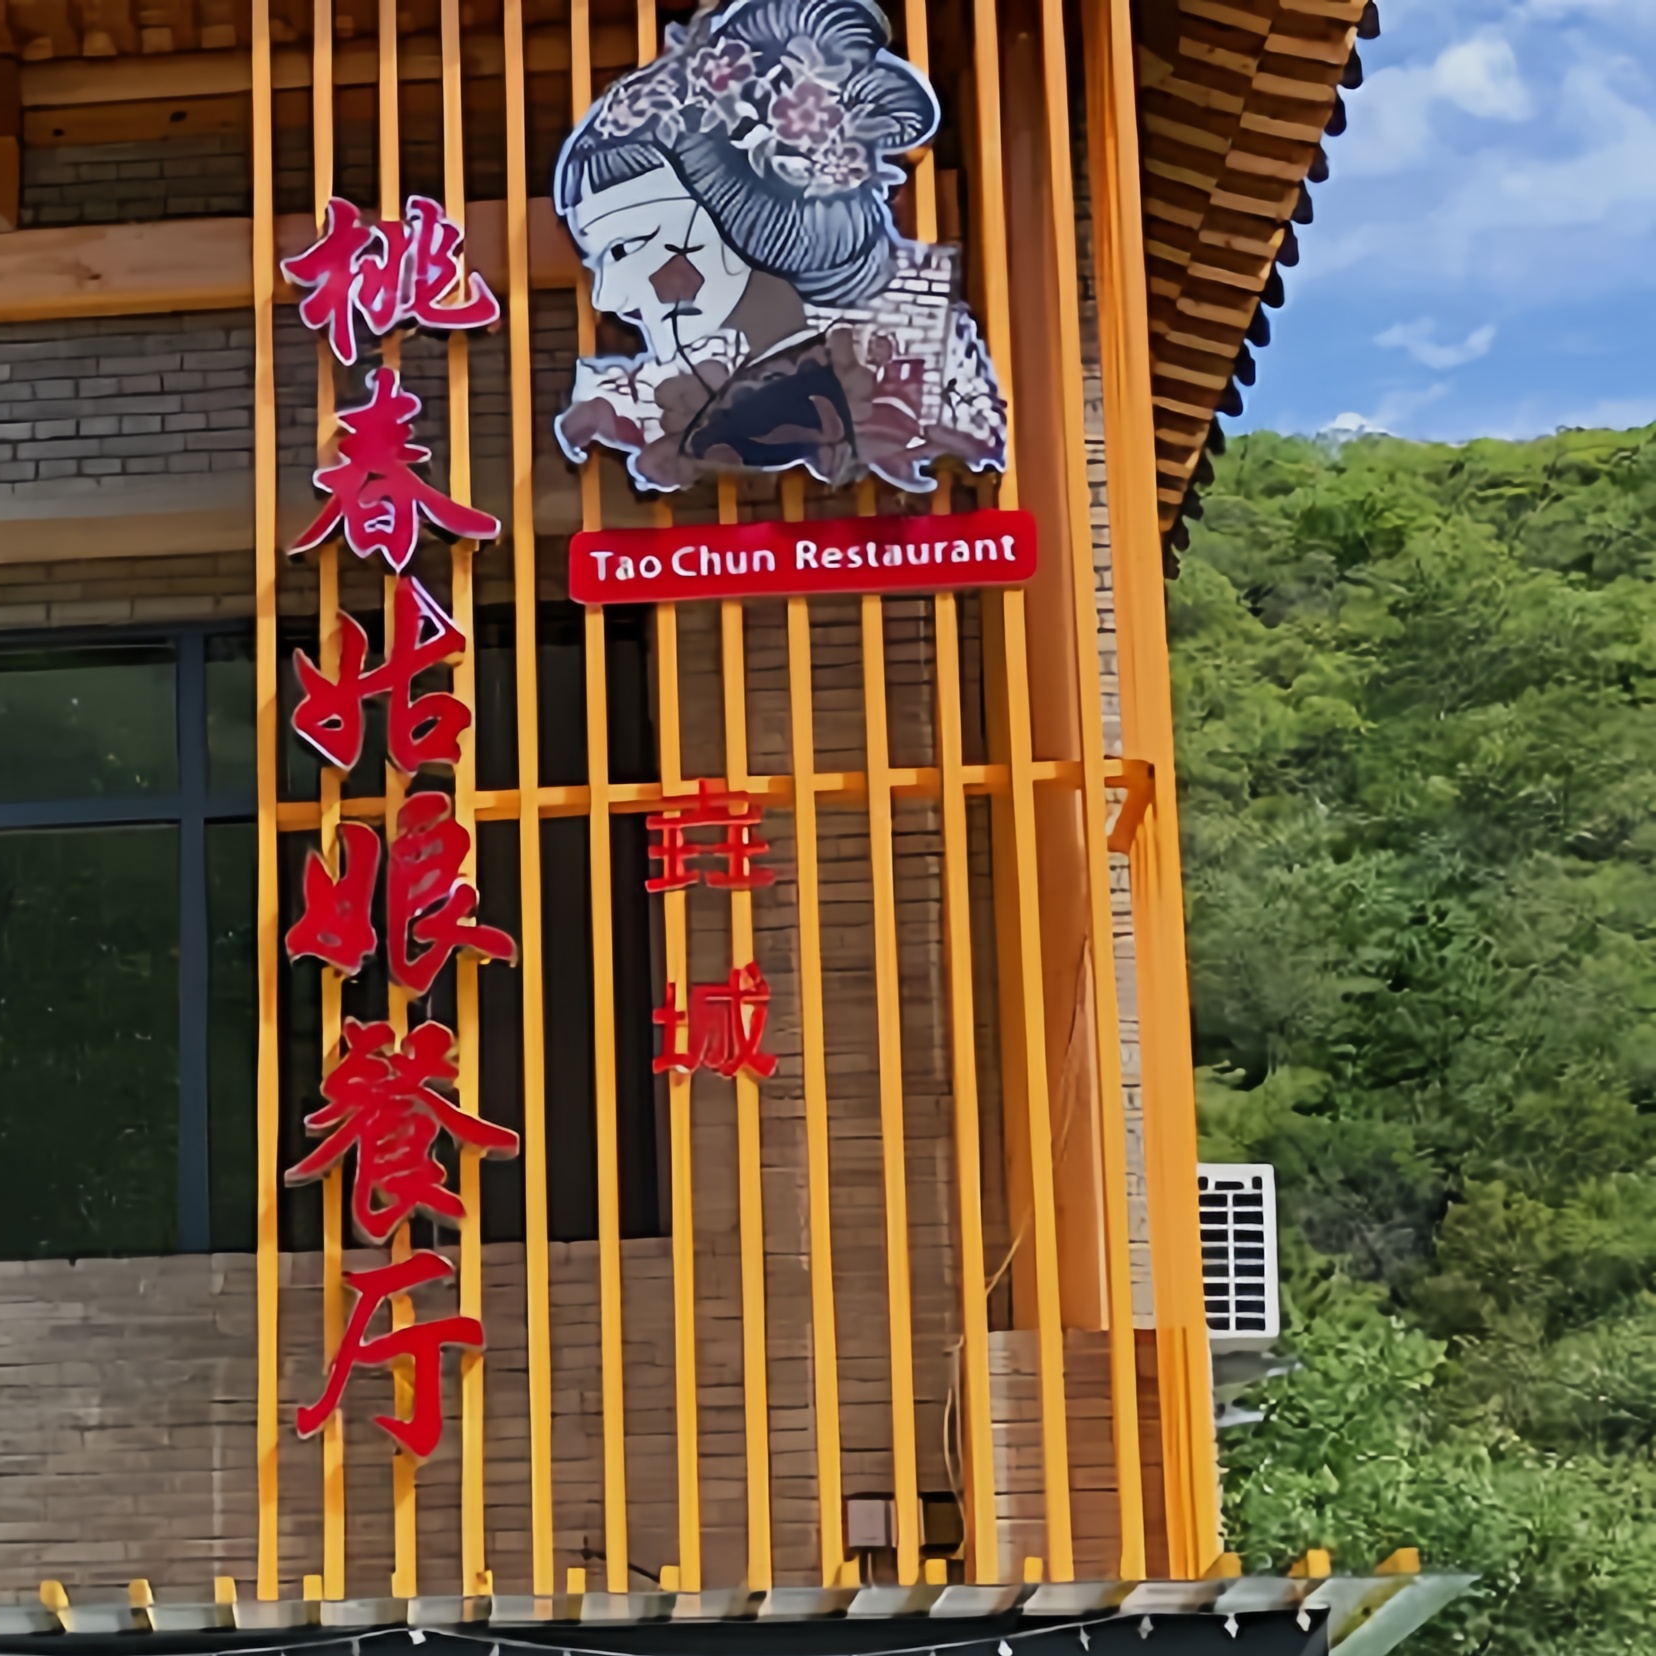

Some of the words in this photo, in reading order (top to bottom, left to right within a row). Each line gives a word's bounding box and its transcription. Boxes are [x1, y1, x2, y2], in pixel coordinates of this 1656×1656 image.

[281, 195, 519, 1456] 桃春姑娘餐厅
[589, 549, 663, 582] Tao
[671, 545, 776, 577] Chun
[794, 534, 1016, 571] Restaurant
